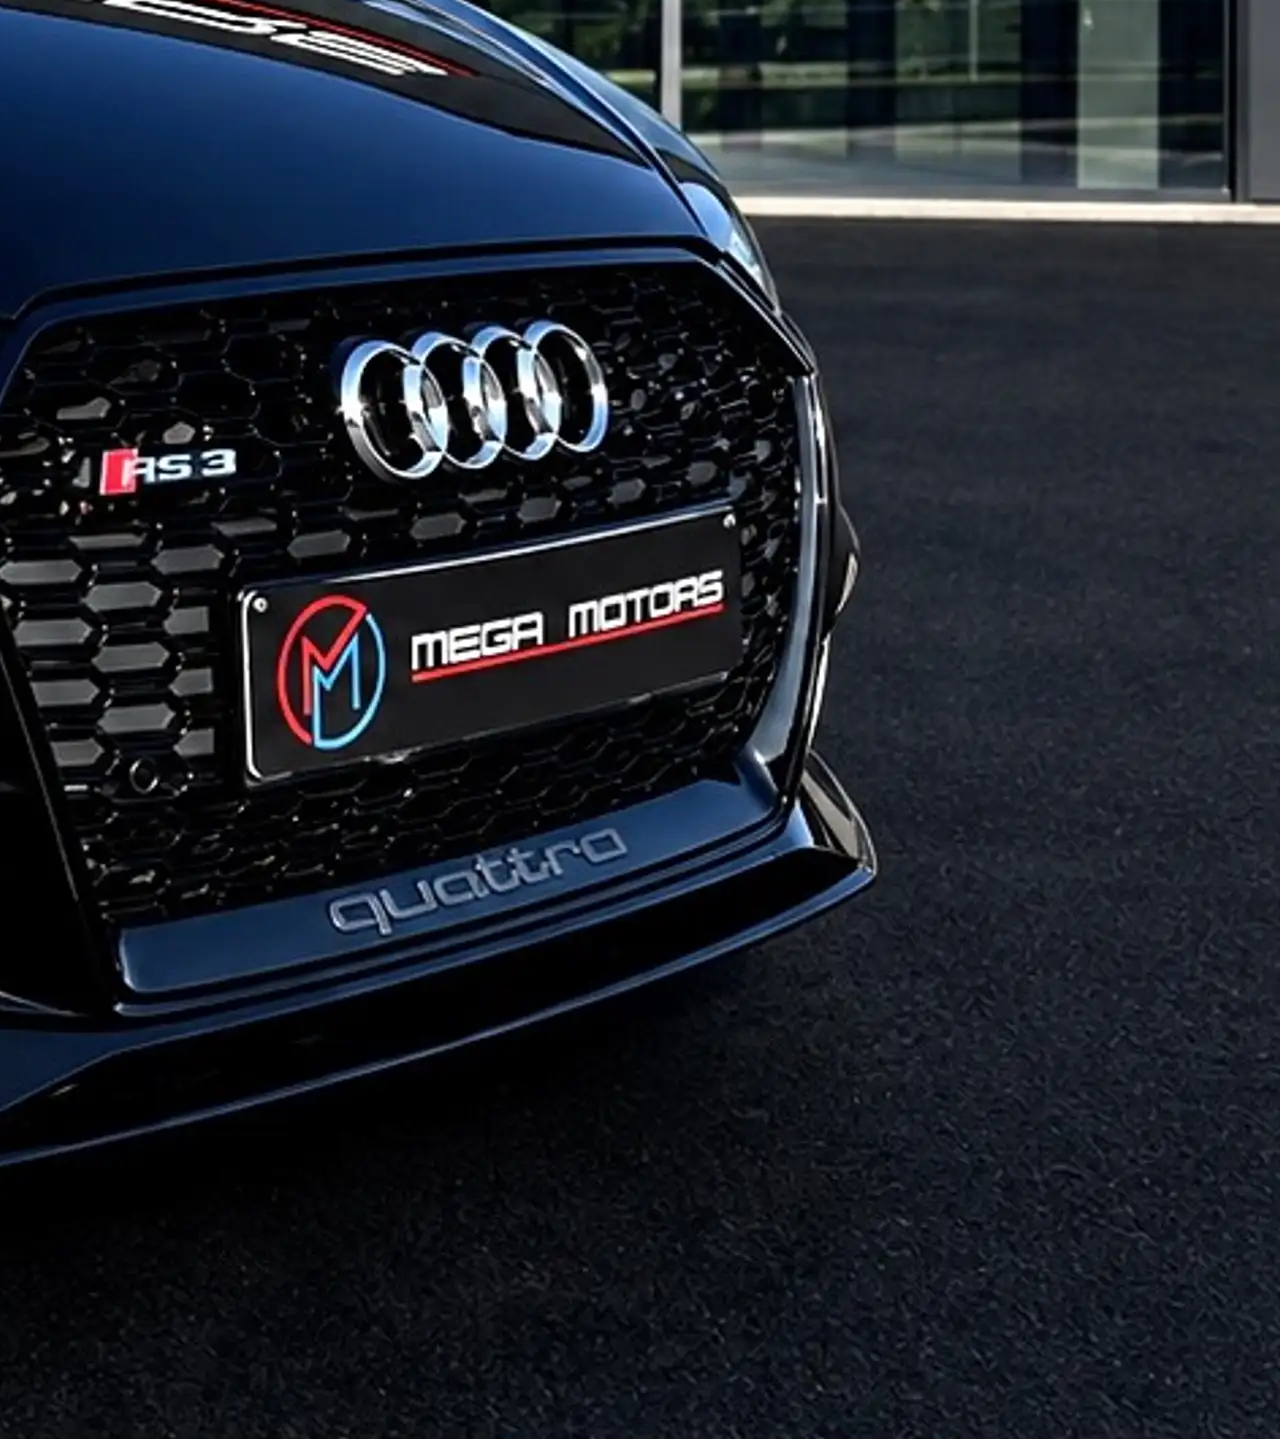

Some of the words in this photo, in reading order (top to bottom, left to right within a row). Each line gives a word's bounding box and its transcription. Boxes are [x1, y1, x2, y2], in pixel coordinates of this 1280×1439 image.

[411, 611, 544, 671] MEGA
[568, 569, 724, 638] MOTORS
[329, 828, 628, 936] quattro
